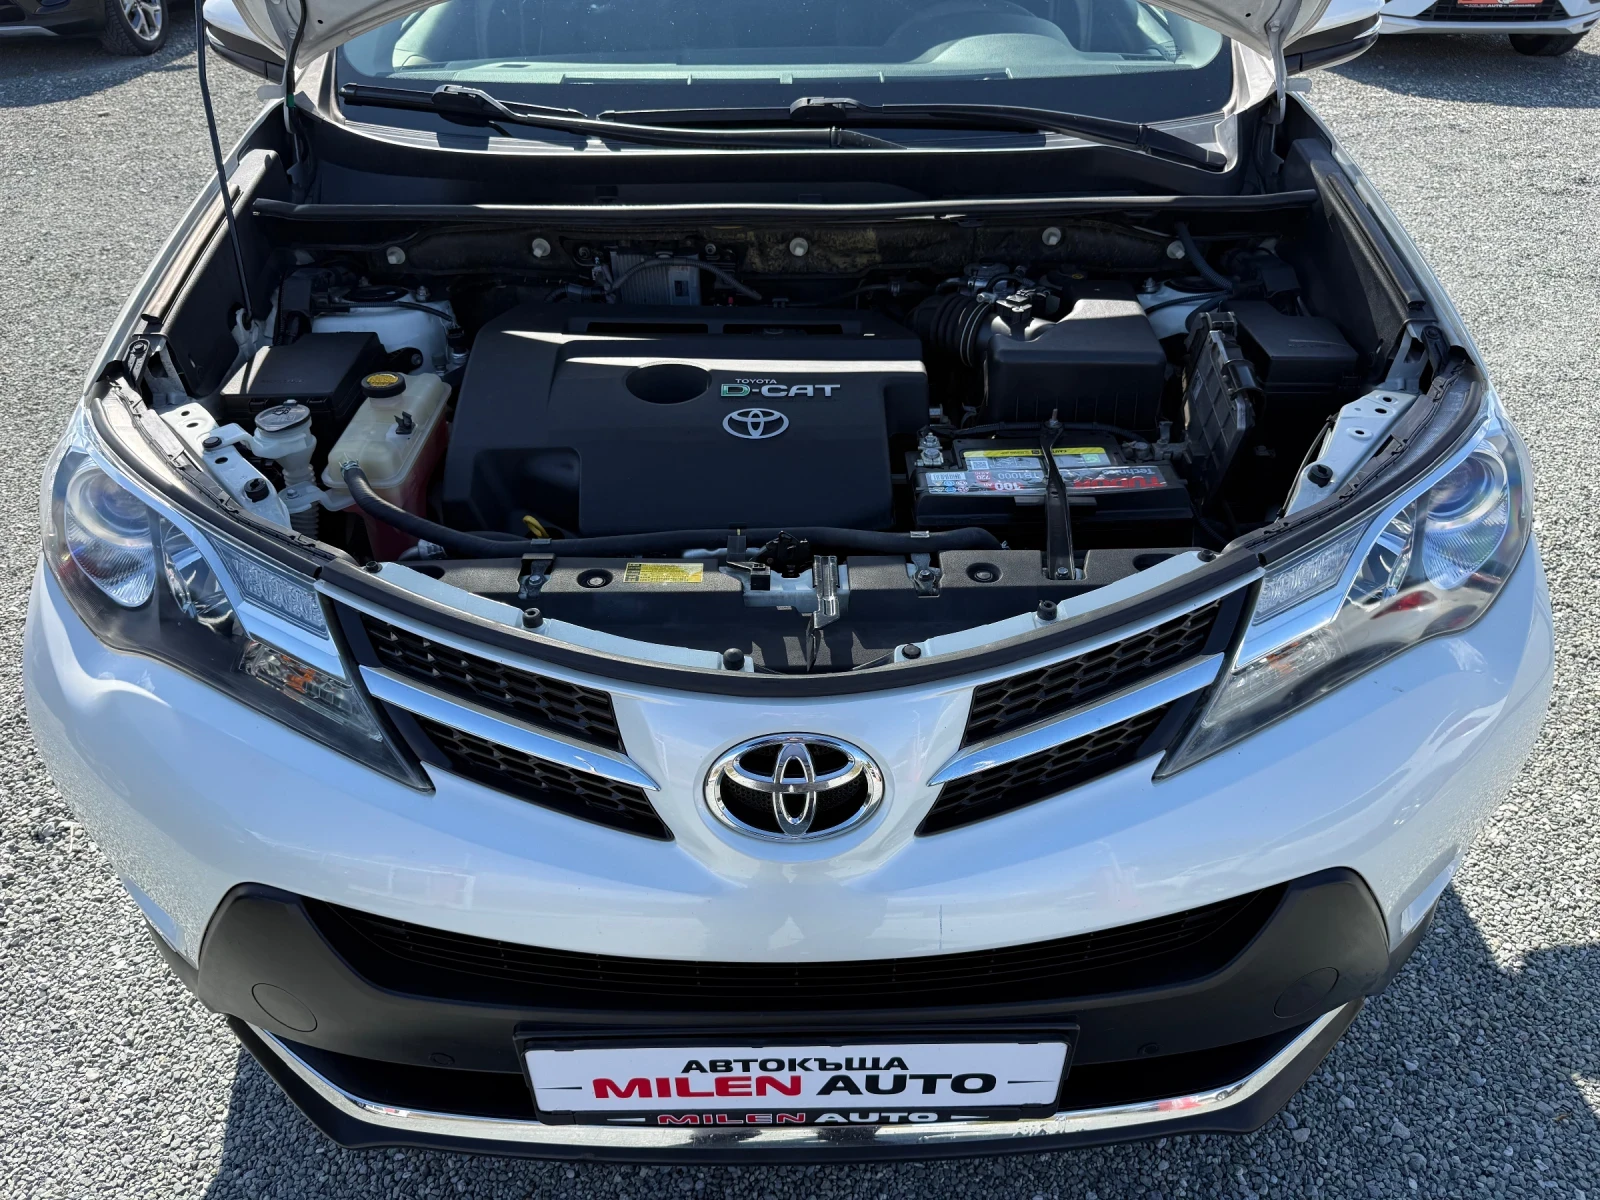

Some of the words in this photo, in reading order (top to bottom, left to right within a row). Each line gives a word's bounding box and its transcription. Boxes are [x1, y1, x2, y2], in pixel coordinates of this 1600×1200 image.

[720, 383, 841, 397] D-CAT
[998, 472, 1039, 480] TB1000
[1074, 476, 1164, 489] TUDOR
[994, 482, 1021, 491] 100
[681, 1057, 909, 1074] АВТОКЪША
[594, 1076, 801, 1099] MILEN
[816, 1073, 996, 1096] AUTO
[658, 1113, 806, 1124] MILEN
[814, 1113, 939, 1123] AUTO
